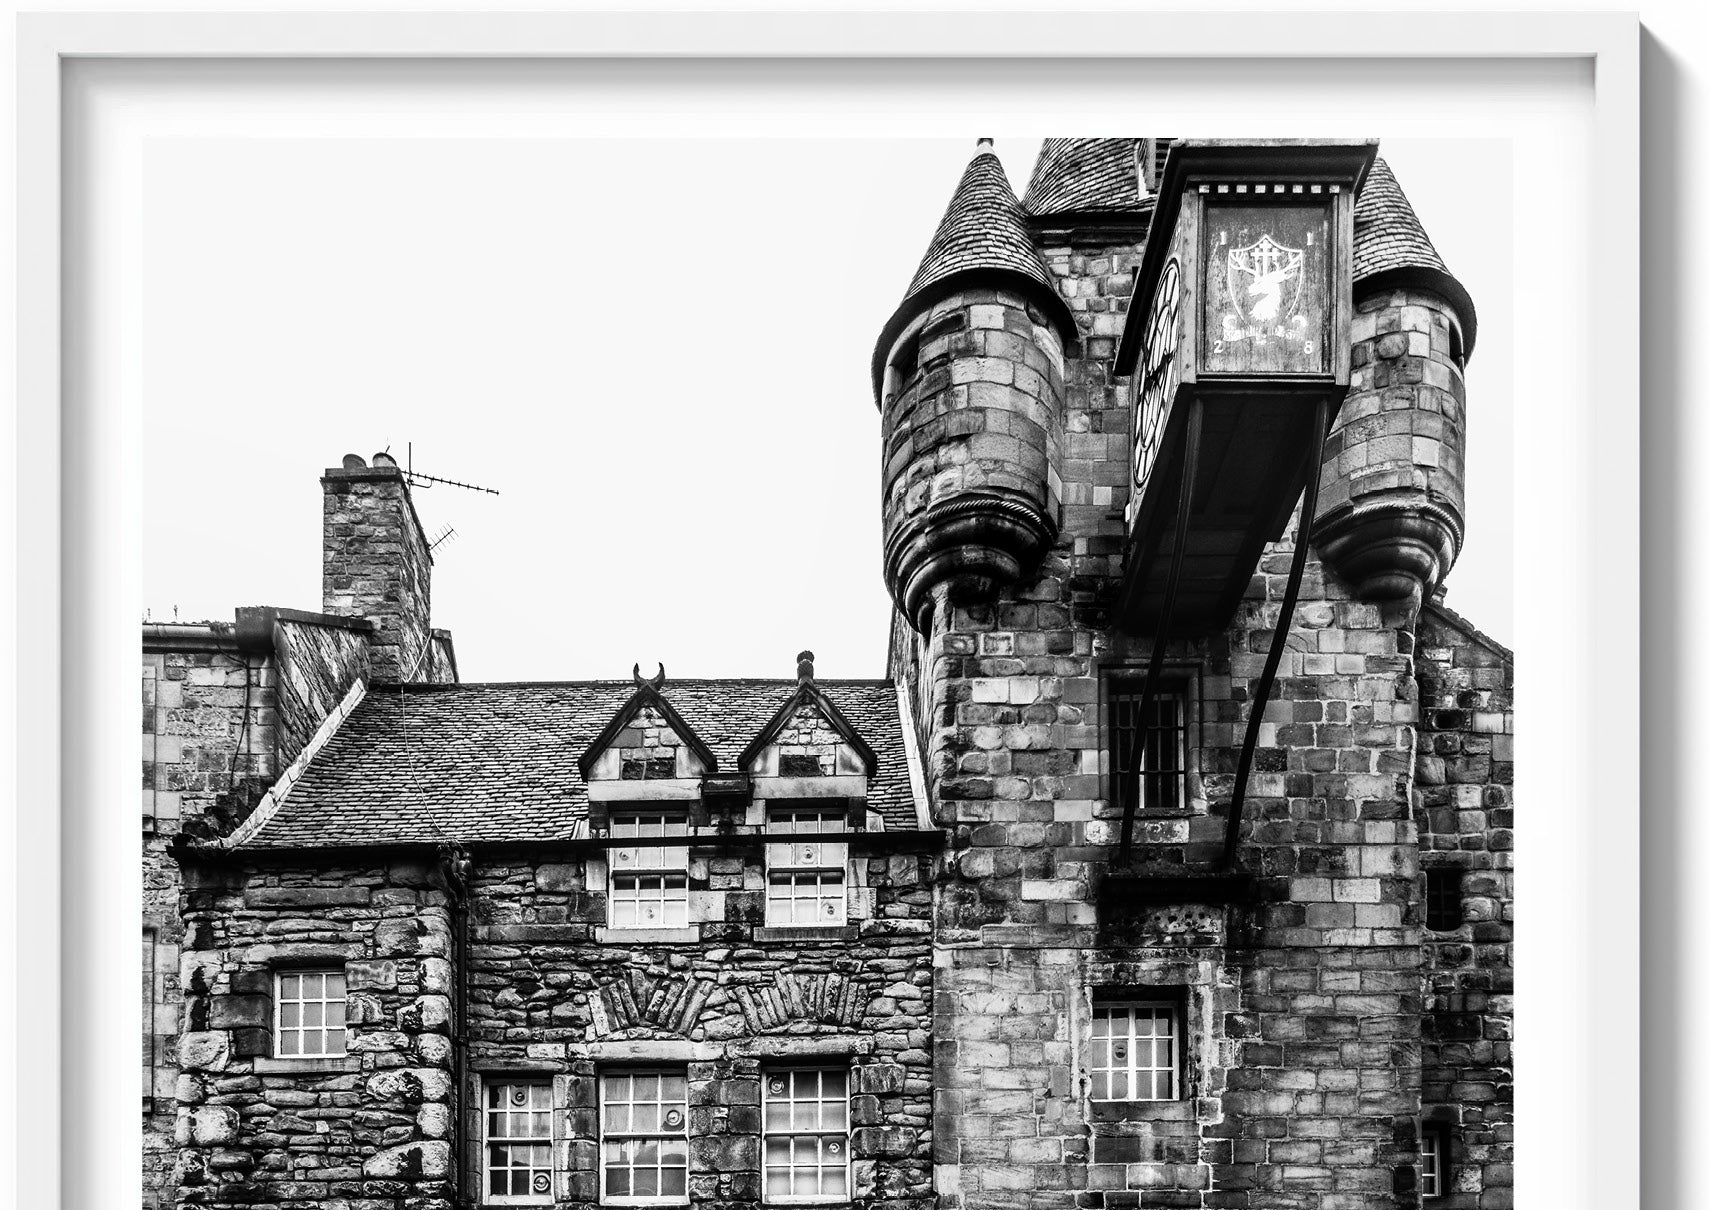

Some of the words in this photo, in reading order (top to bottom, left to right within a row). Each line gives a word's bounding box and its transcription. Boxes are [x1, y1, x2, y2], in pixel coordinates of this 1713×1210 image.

[1220, 231, 1227, 246] 1
[1307, 231, 1314, 246] 1
[1213, 339, 1224, 354] 2
[1303, 340, 1314, 355] 8
